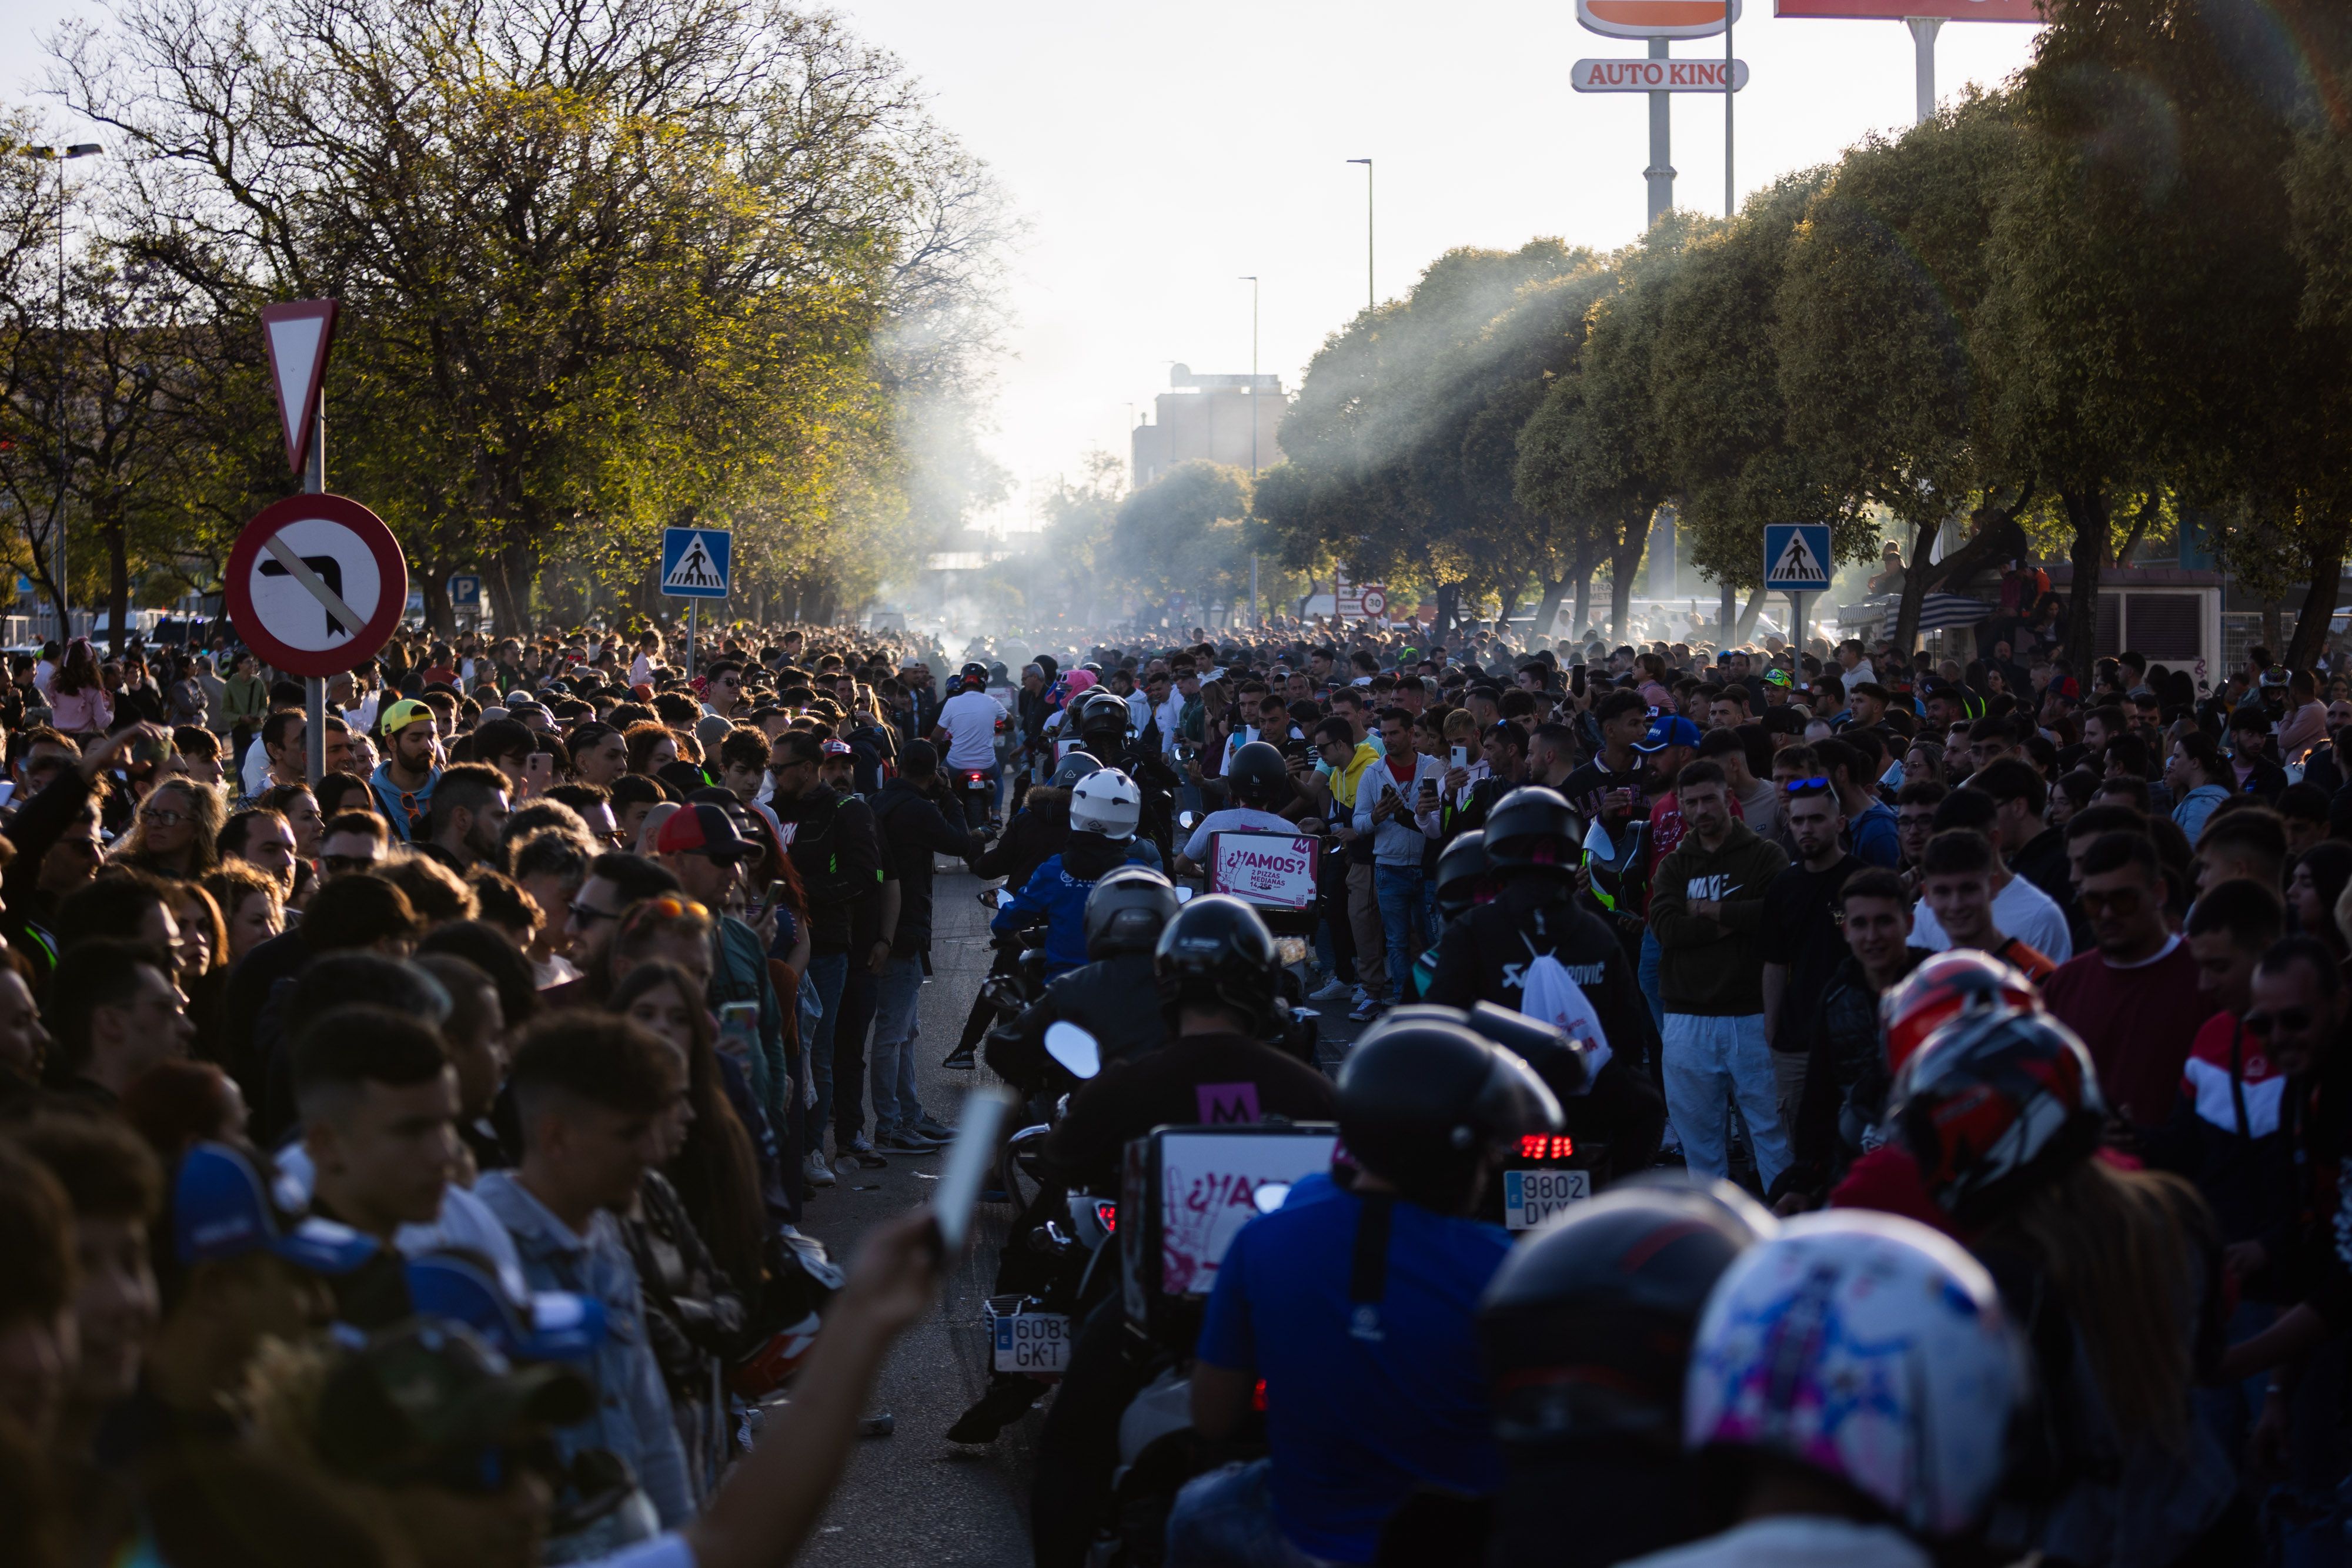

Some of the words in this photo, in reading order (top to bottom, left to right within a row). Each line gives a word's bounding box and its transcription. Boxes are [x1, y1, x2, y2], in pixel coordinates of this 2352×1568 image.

[1588, 64, 1663, 85] AUTO
[1669, 64, 1735, 85] KING
[457, 580, 475, 600] P
[1369, 599, 1381, 608] 30
[1227, 850, 1306, 875] ¿VAMOS?
[1251, 875, 1285, 886] MEDIANAS
[1257, 871, 1280, 879] PIZZAS
[1524, 1176, 1584, 1199] 9802
[1016, 1320, 1072, 1339] 6083
[1000, 1335, 1010, 1345] E
[1016, 1342, 1061, 1366] GKT
